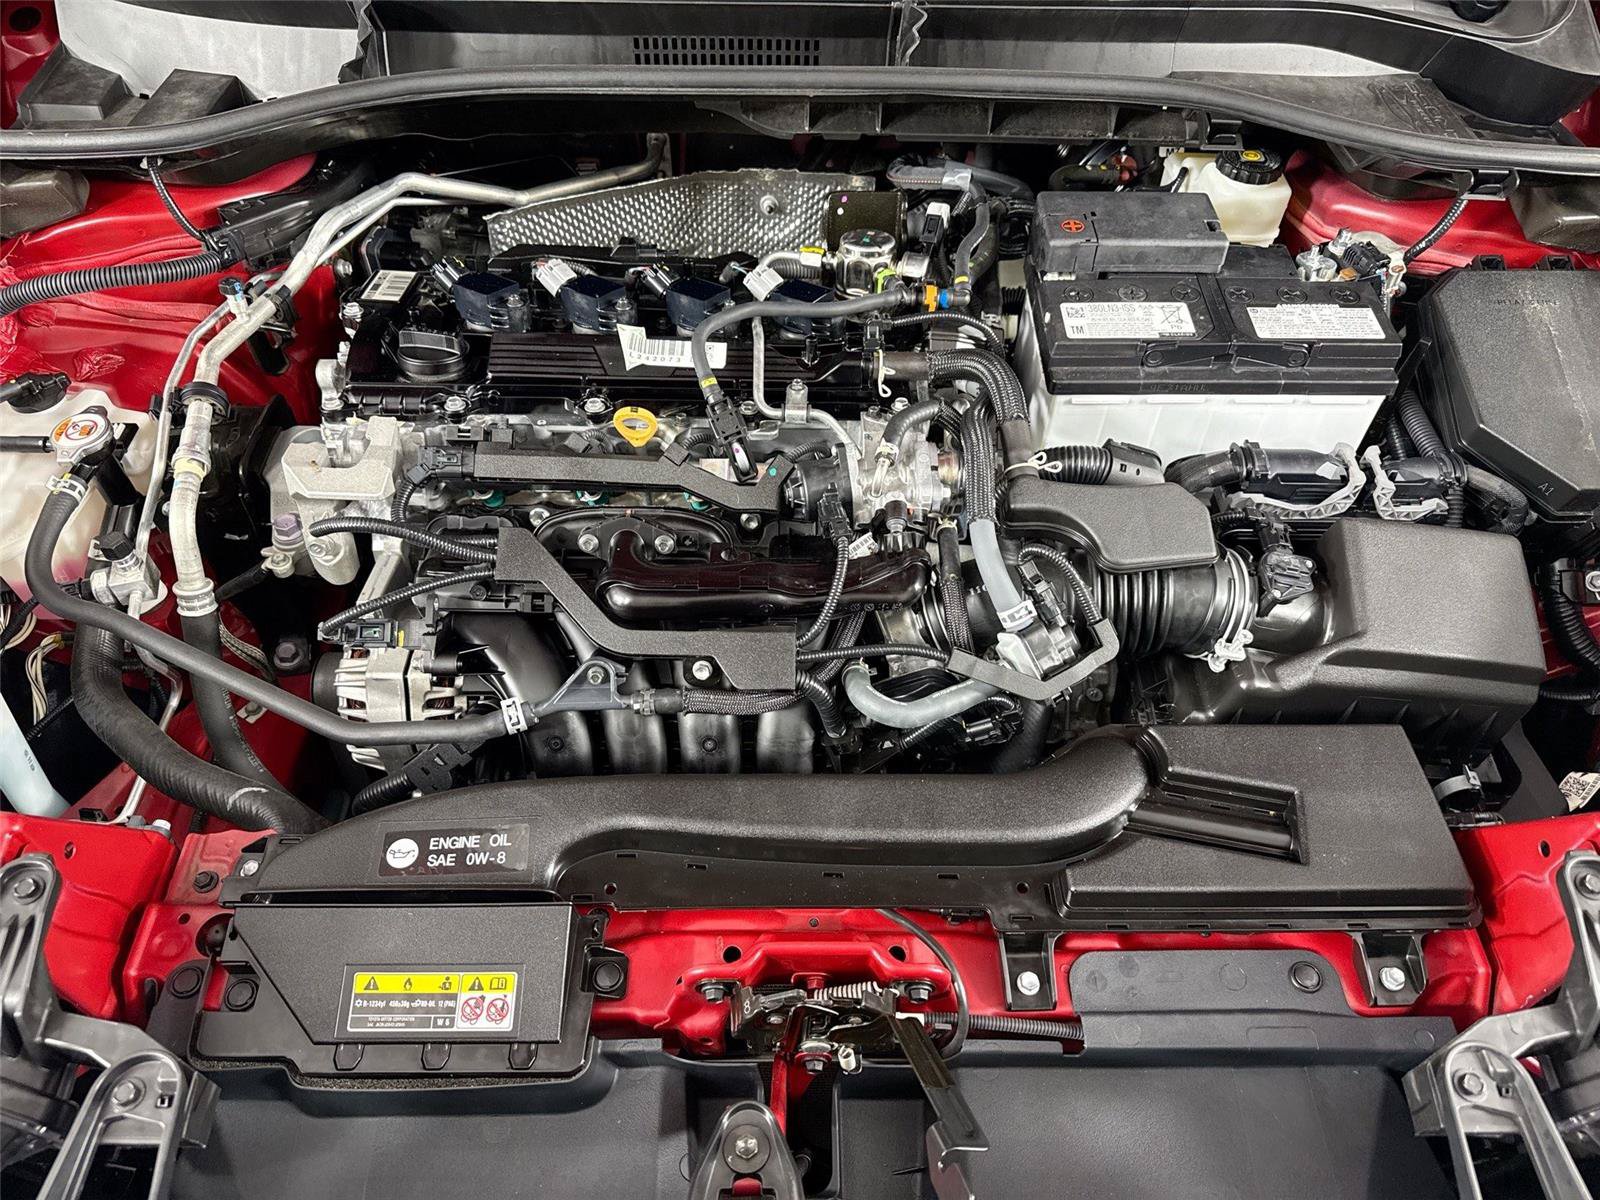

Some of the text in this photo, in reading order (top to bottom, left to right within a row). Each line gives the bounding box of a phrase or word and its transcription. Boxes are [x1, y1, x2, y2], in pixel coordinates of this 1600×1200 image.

[1070, 326, 1085, 335] TM
[1538, 483, 1554, 496] A1
[429, 834, 512, 850] ENGINE OIL
[427, 851, 506, 867] SAE 0W-8
[743, 1000, 751, 1014] 8
